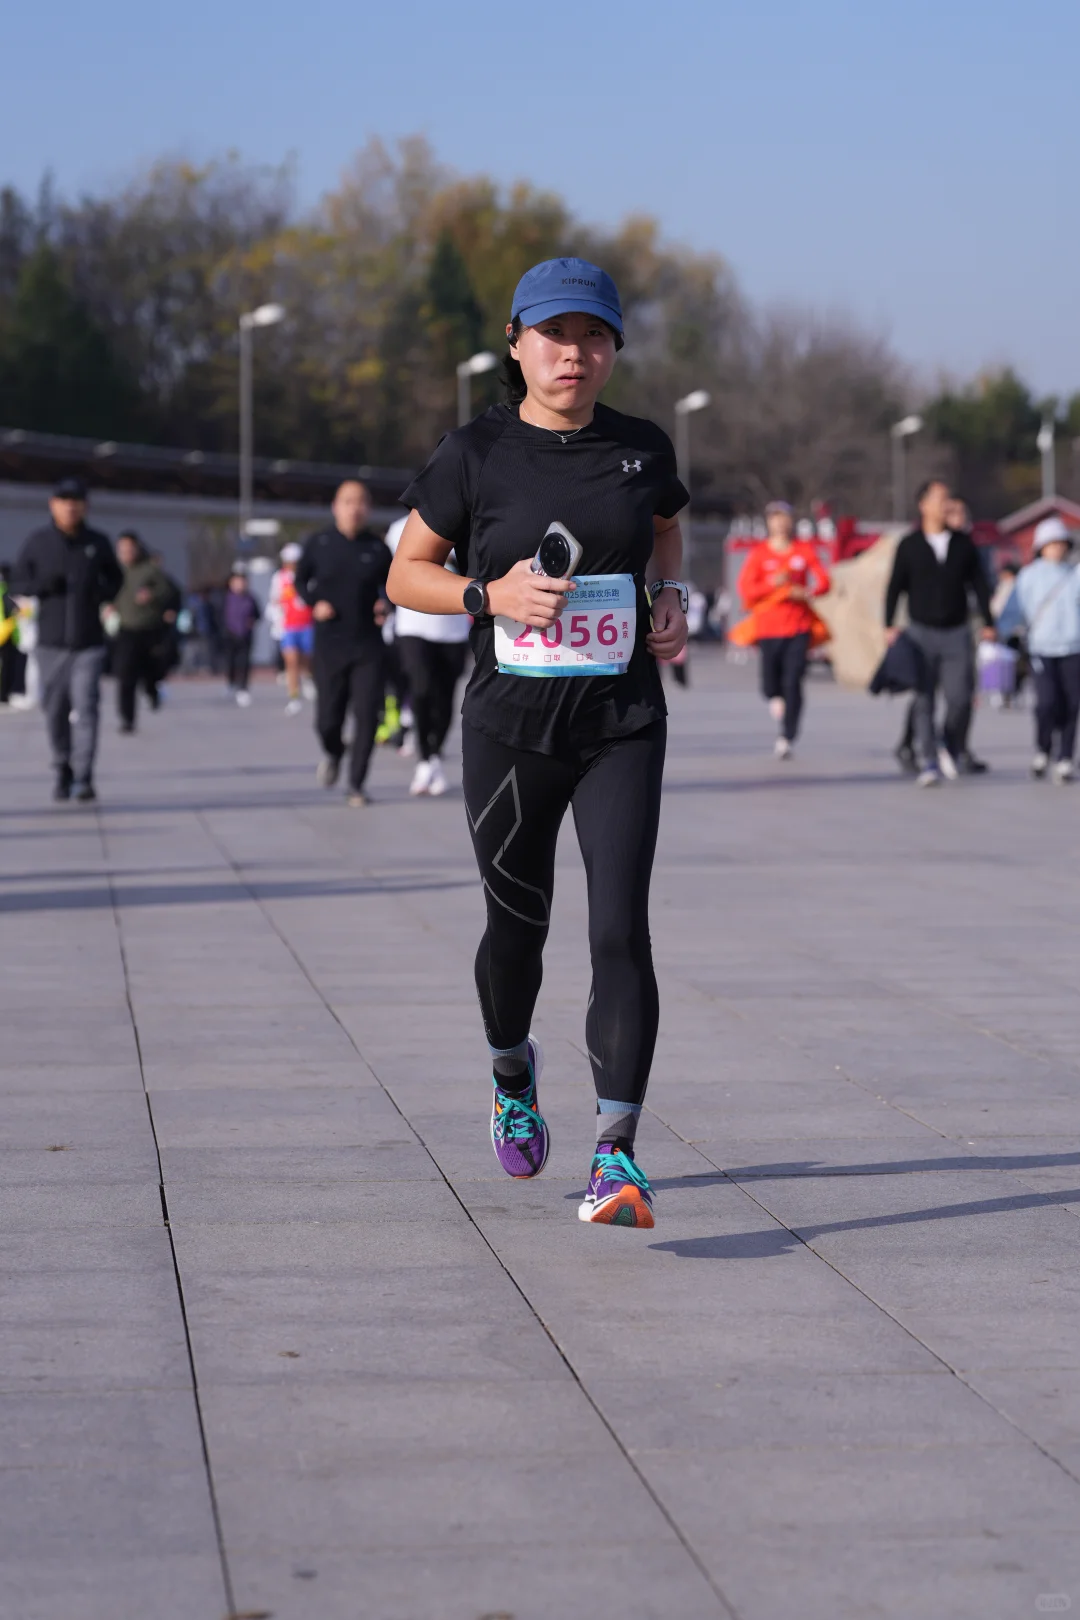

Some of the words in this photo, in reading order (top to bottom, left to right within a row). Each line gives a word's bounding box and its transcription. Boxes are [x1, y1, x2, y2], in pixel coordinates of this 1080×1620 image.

[561, 278, 596, 288] KIPRUN
[564, 588, 620, 599] 025奥森欢乐跑
[513, 613, 618, 648] 2056
[522, 653, 529, 661] 存
[553, 654, 561, 662] 取
